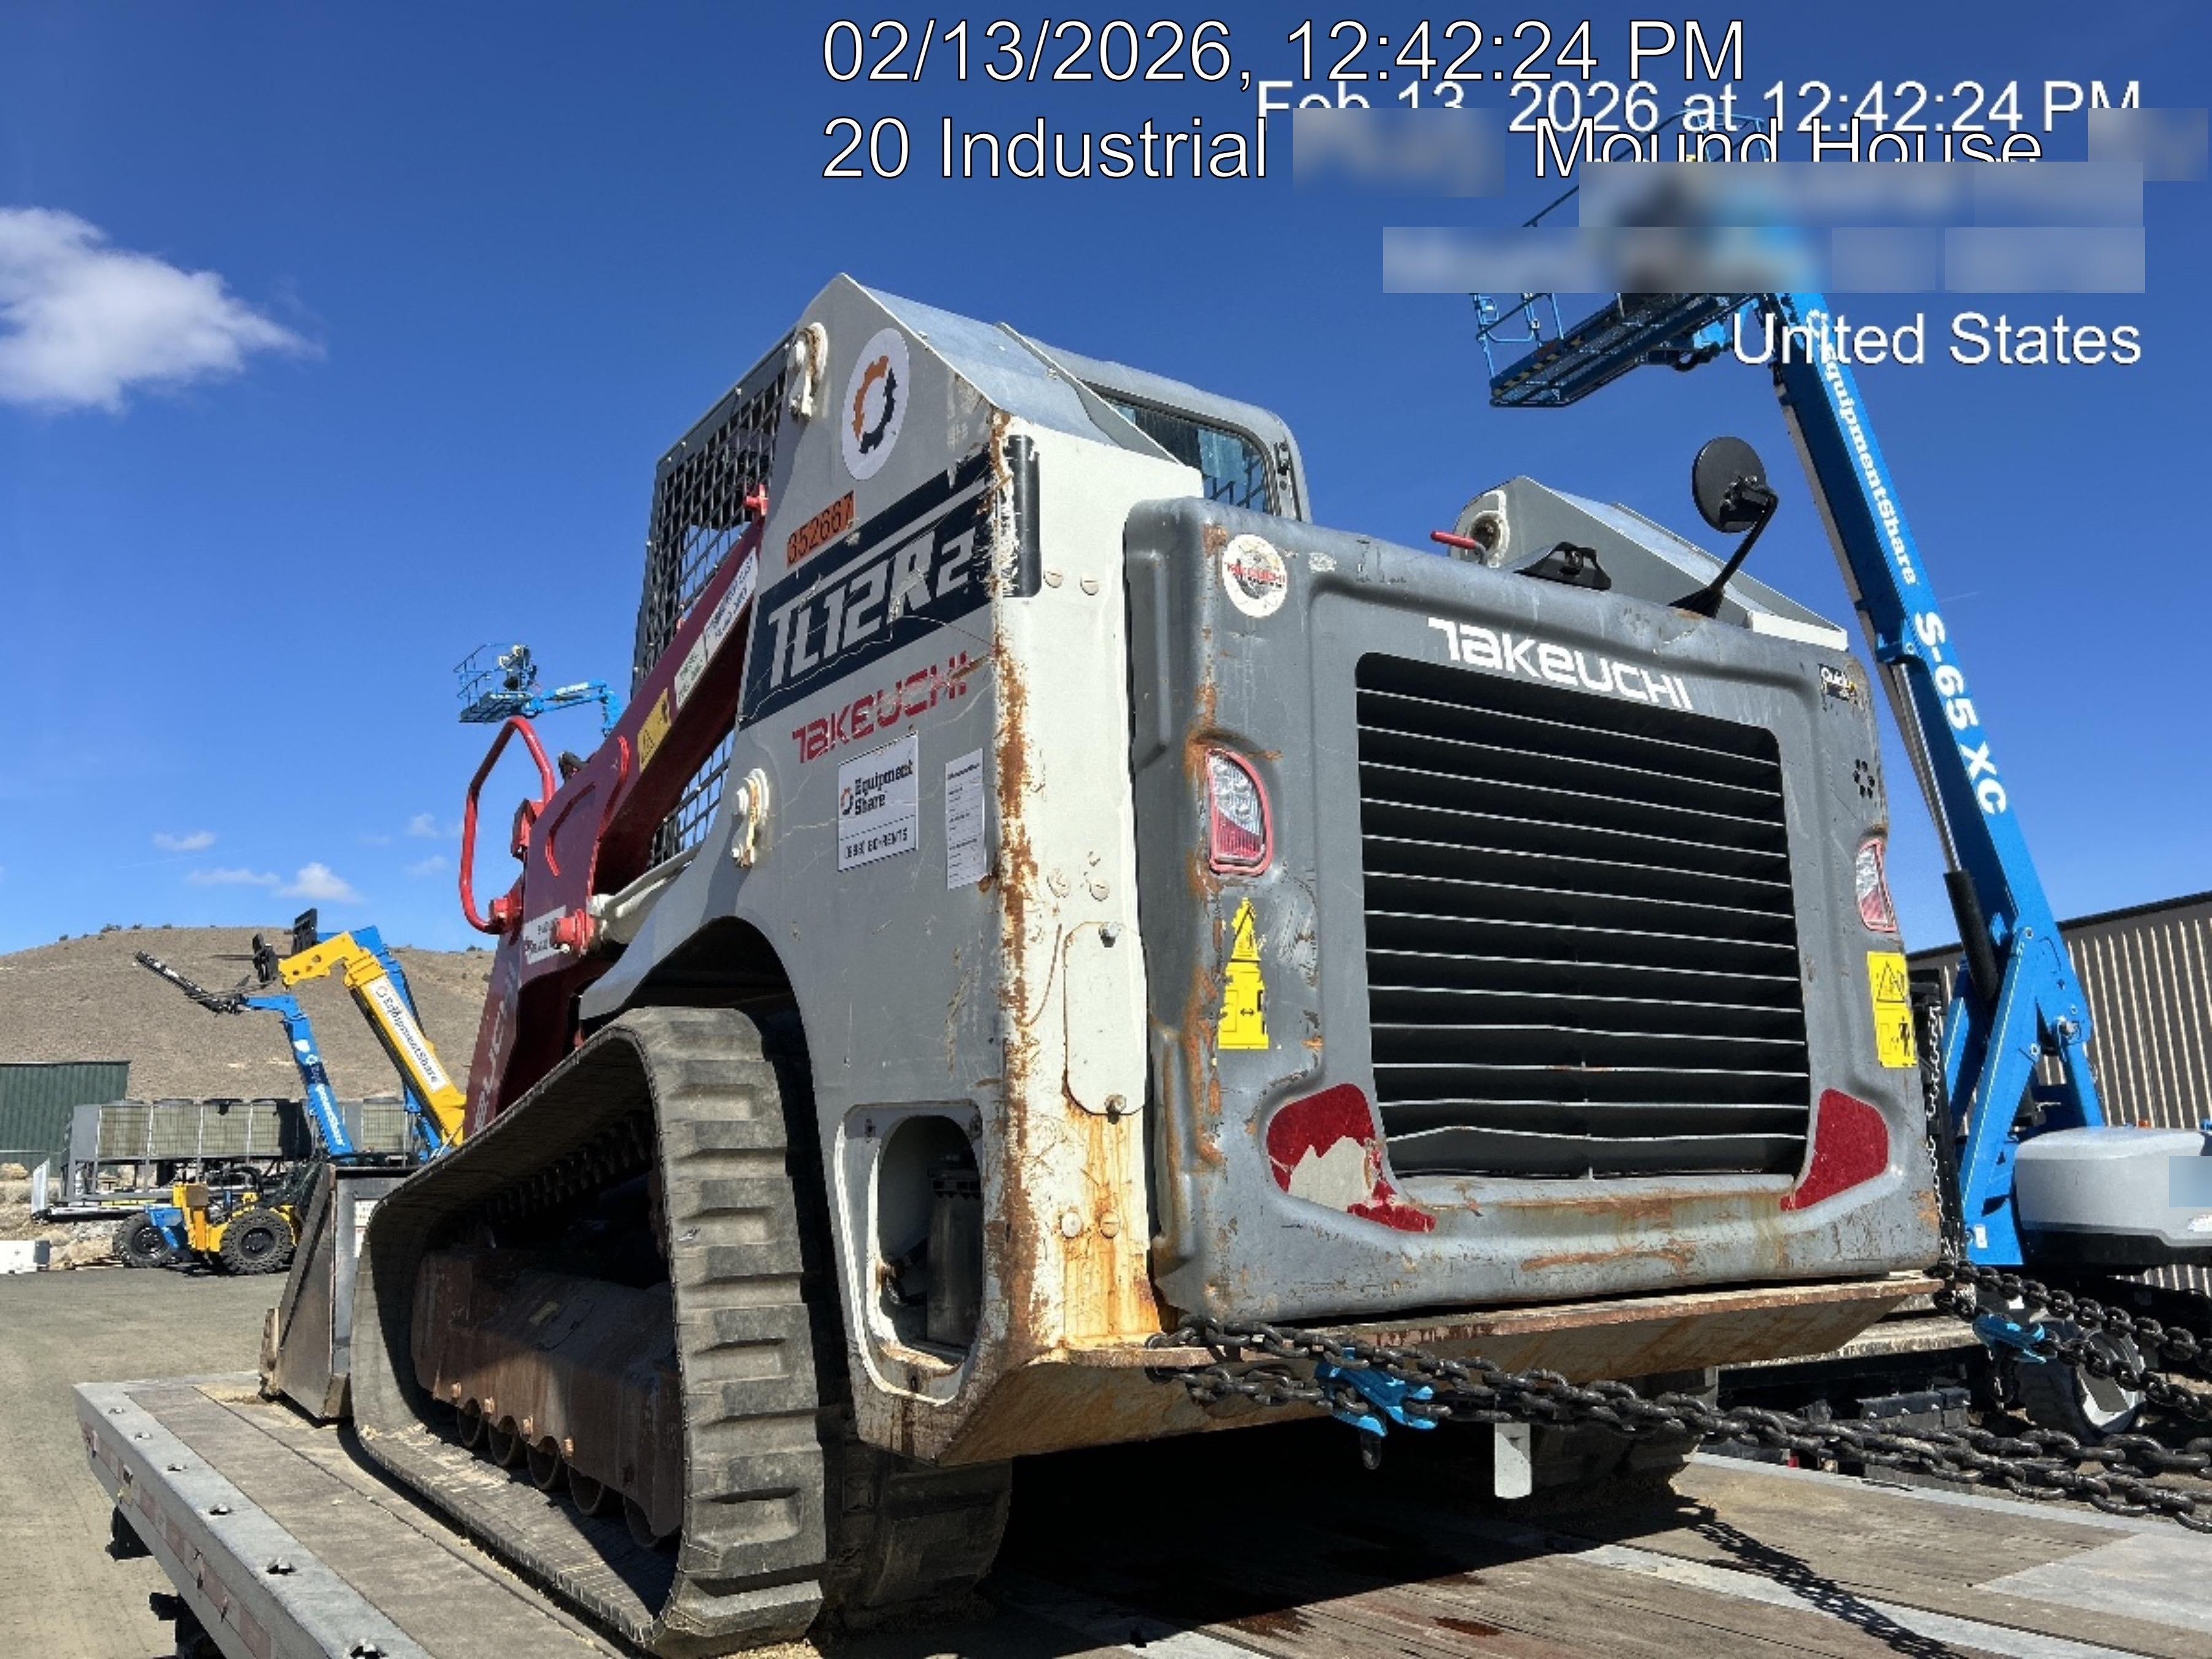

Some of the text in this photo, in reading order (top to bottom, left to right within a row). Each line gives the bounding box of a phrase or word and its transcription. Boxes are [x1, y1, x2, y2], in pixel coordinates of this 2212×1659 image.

[768, 527, 976, 688] TL12R2
[793, 651, 967, 763] TAKEUCHI
[1428, 616, 1694, 710] TAKEUCHI
[1915, 611, 2006, 815] S-65 XC
[855, 759, 913, 796] Equipment
[855, 794, 885, 815] Share
